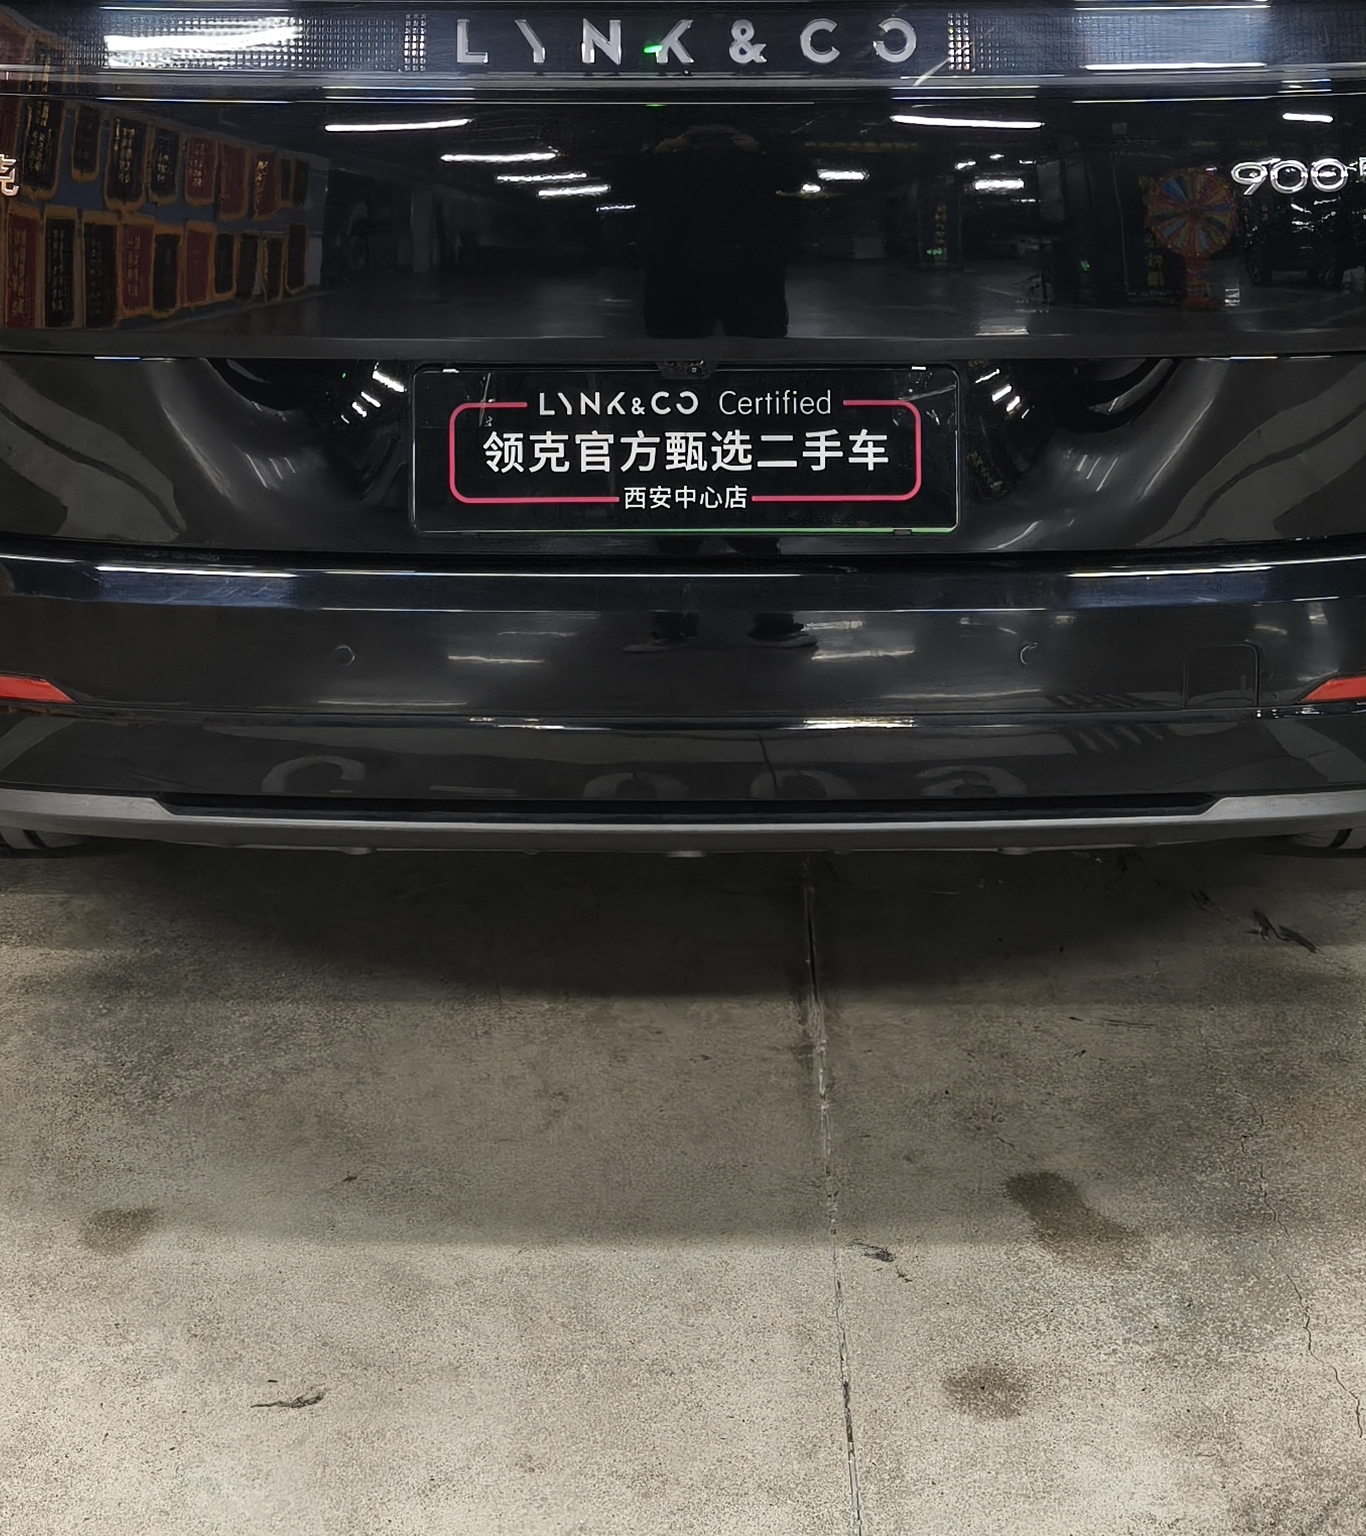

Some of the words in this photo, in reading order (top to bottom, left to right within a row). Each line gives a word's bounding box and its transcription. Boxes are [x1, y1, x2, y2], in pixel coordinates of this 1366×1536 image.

[455, 17, 919, 64] LYNK&CO
[1230, 157, 1349, 195] 900
[538, 390, 699, 416] LYNK&CO
[718, 389, 832, 416] Certified
[482, 428, 890, 474] 领克官方甄选二手车
[623, 485, 748, 511] 西安中心店
